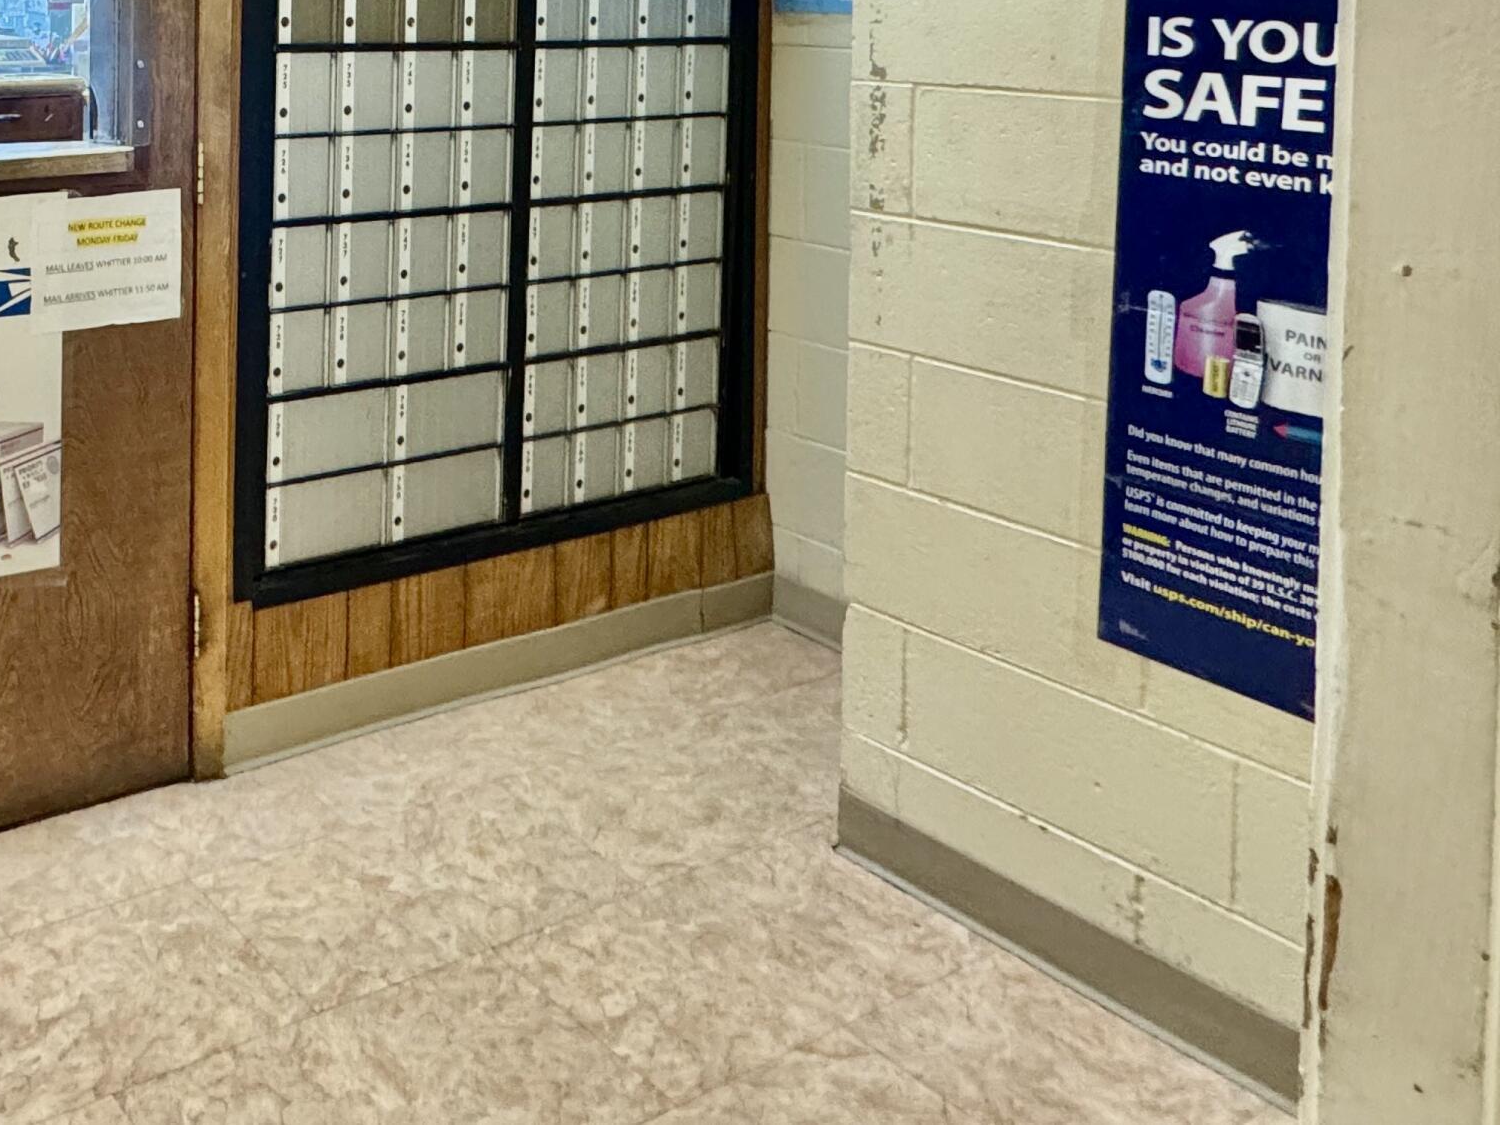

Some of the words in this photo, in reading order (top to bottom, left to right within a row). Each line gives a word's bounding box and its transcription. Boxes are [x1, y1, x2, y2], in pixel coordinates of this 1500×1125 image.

[1147, 16, 1193, 58] IS
[1212, 18, 1338, 66] YOU
[1143, 69, 1326, 133] SAFE
[1140, 132, 1187, 153] You
[1192, 140, 1265, 162] could
[1272, 144, 1308, 167] be
[1140, 157, 1188, 177] and
[1194, 165, 1240, 183] not
[1245, 172, 1311, 192] even
[69, 223, 85, 231] NEW
[89, 221, 112, 229] ROUTE
[115, 219, 146, 227] CHANGE
[46, 264, 65, 274] MAIL
[68, 261, 94, 271] LEAVES
[96, 259, 131, 268] WHITTIER
[44, 295, 62, 305] MAIL
[65, 291, 96, 303] ARRIVES
[98, 287, 133, 297] WHITTIER
[1270, 358, 1323, 382] VARN
[1304, 353, 1321, 361] OR
[1128, 424, 1144, 438] Did
[1145, 429, 1163, 444] you
[1165, 433, 1192, 452] know
[1194, 443, 1215, 457] that
[1218, 450, 1246, 468] many
[1249, 457, 1298, 479] common
[1127, 450, 1149, 464] Even
[1152, 453, 1180, 474] items
[1182, 466, 1204, 480] that
[1205, 472, 1222, 486] are
[1224, 476, 1281, 500] permitted
[1283, 491, 1295, 504] in
[1297, 496, 1317, 510] the
[1121, 570, 1152, 592] Visit
